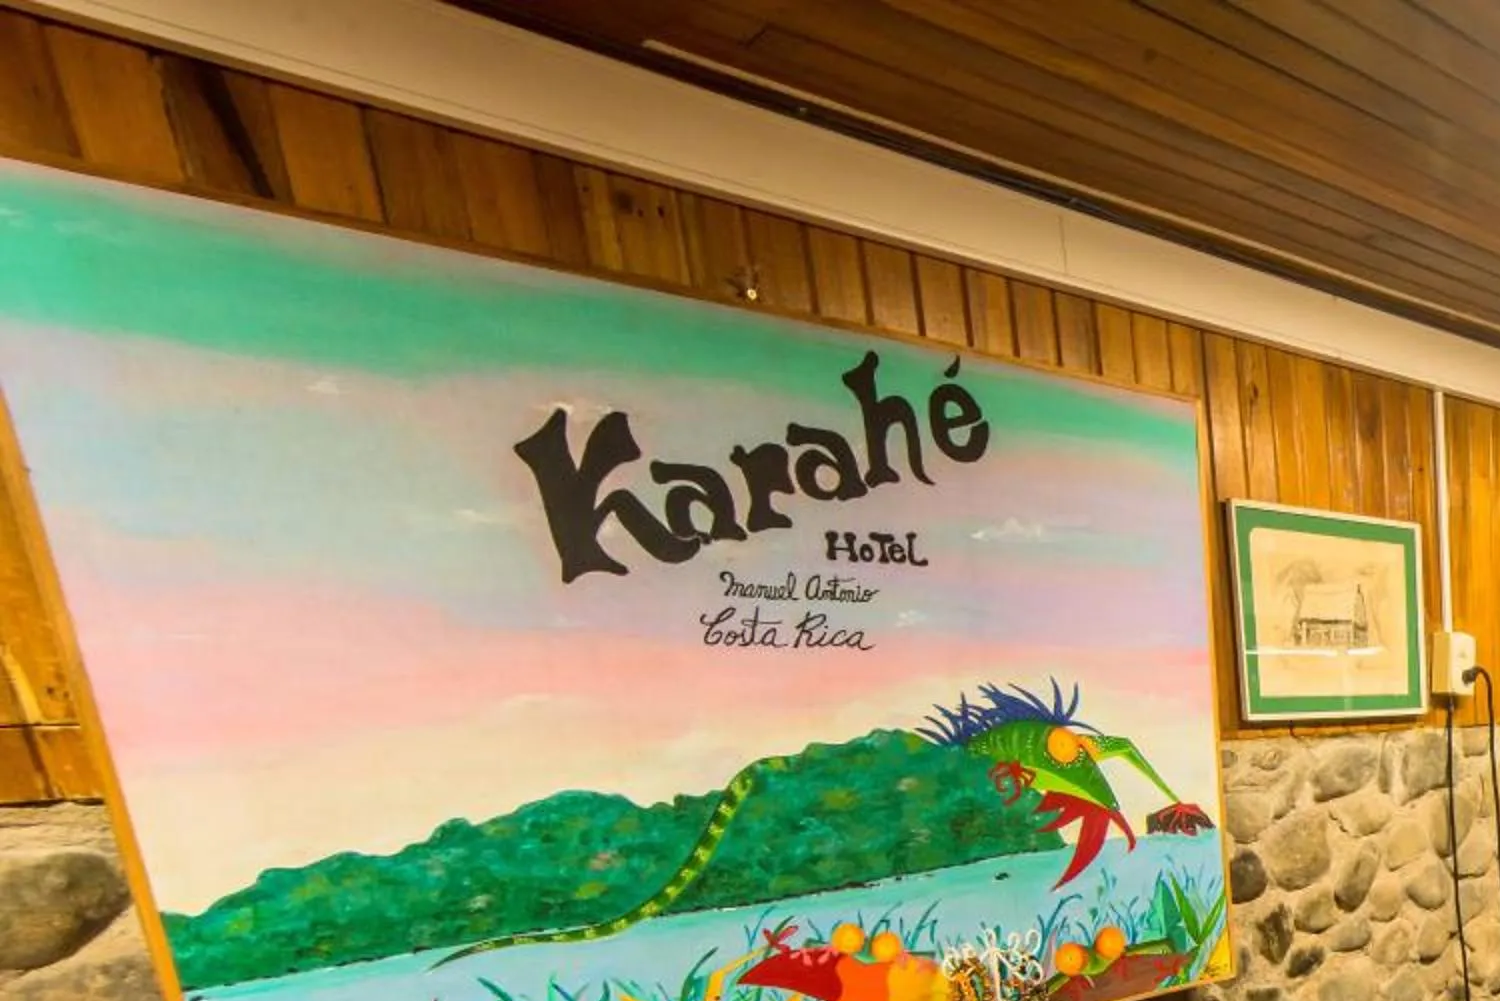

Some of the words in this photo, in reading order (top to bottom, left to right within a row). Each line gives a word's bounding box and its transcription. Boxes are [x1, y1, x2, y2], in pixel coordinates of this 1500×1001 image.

[513, 350, 990, 584] Karahé
[719, 571, 799, 602] Manuel
[804, 575, 880, 602] Antonio
[699, 606, 788, 648] Costa
[794, 611, 874, 651] Rica
